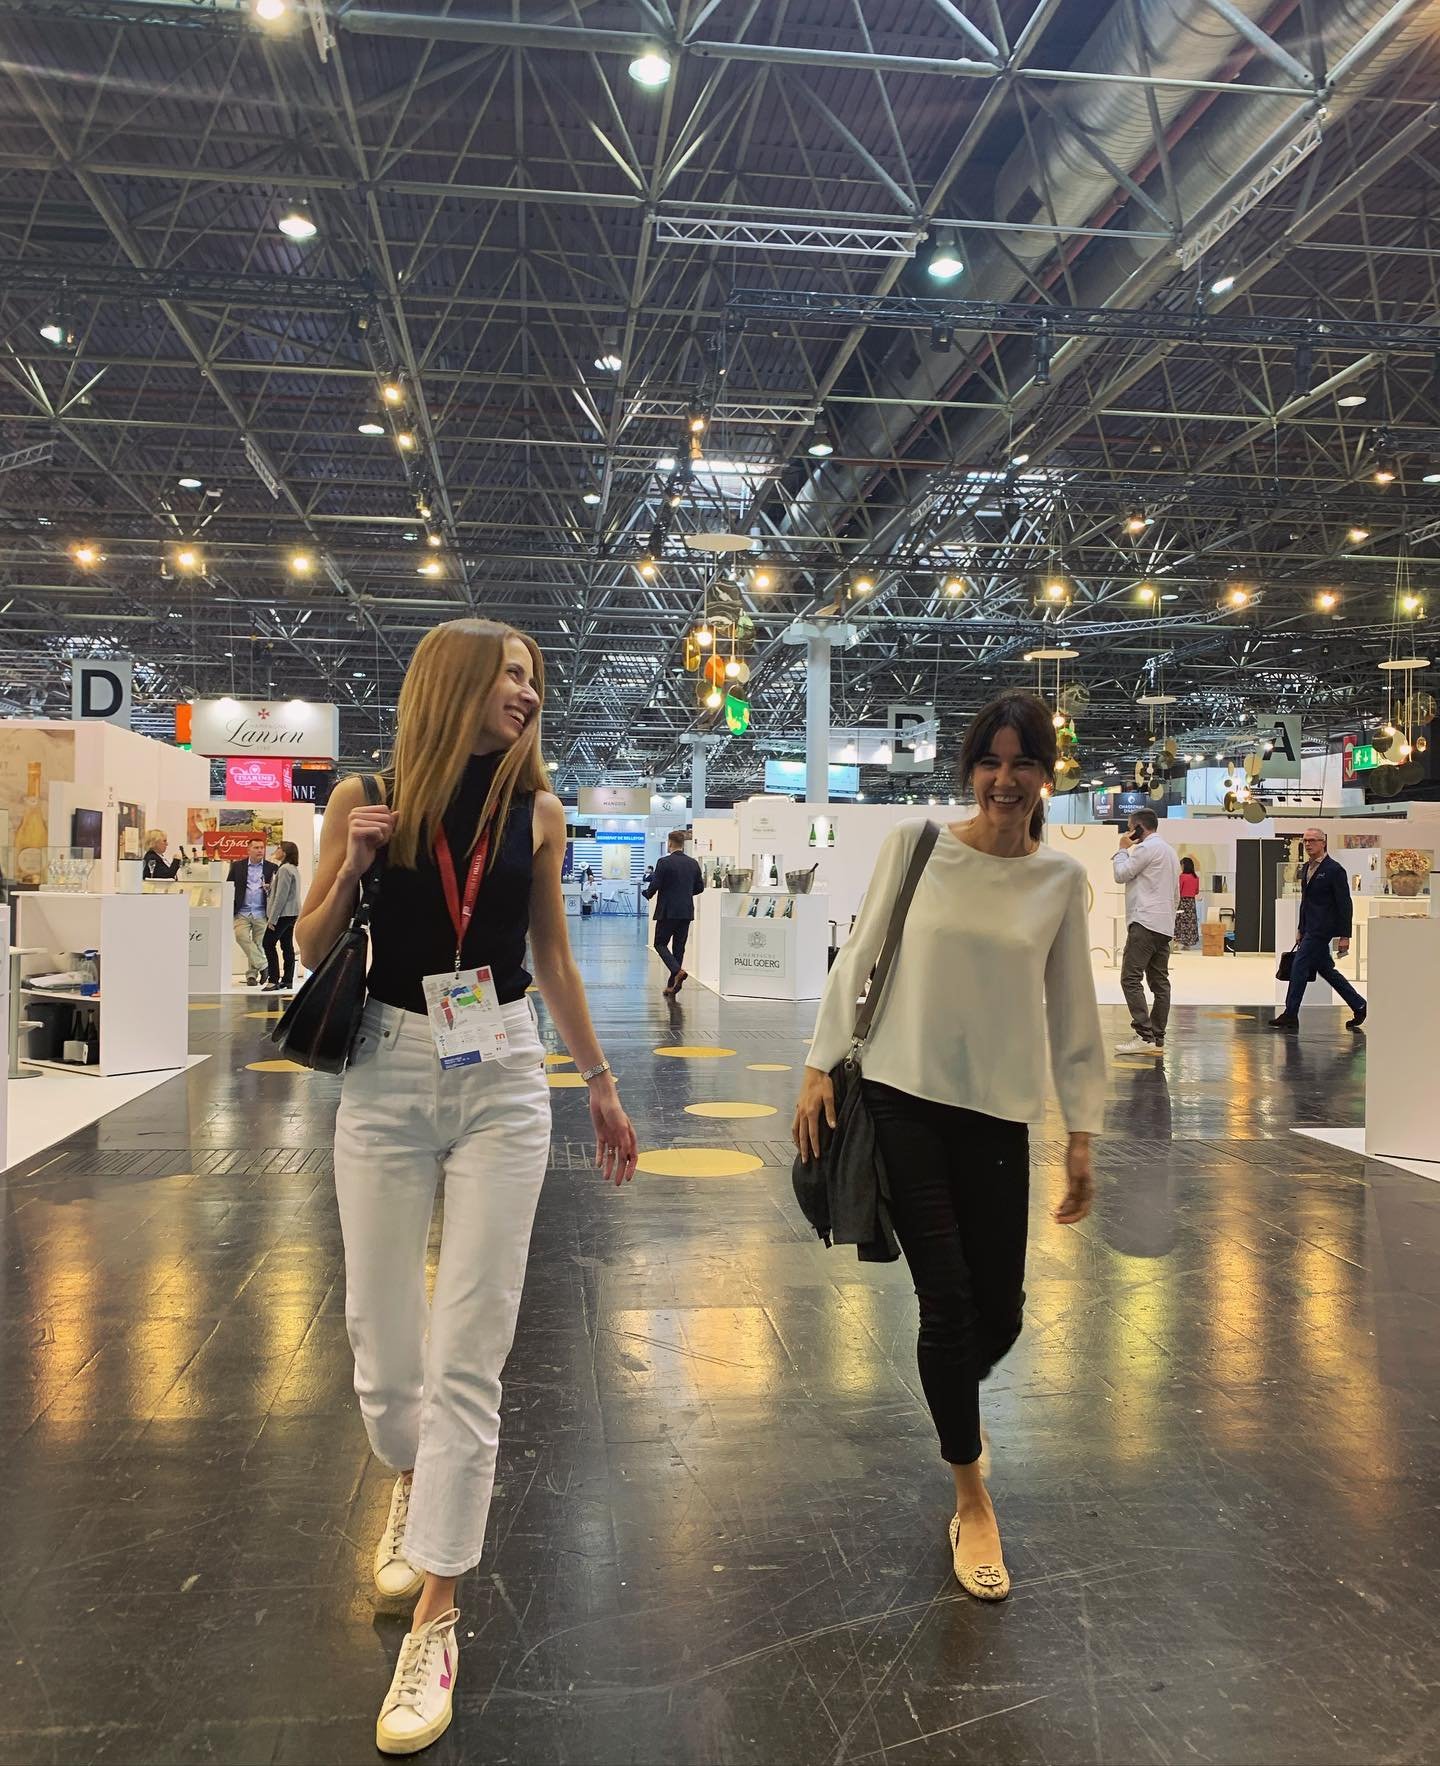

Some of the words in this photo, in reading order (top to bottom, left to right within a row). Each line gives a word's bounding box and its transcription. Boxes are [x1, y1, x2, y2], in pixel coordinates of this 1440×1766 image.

[81, 669, 123, 717] D
[226, 720, 304, 747] Lanson
[1262, 722, 1296, 761] A
[734, 957, 753, 967] PAUL
[753, 958, 780, 969] GOERG
